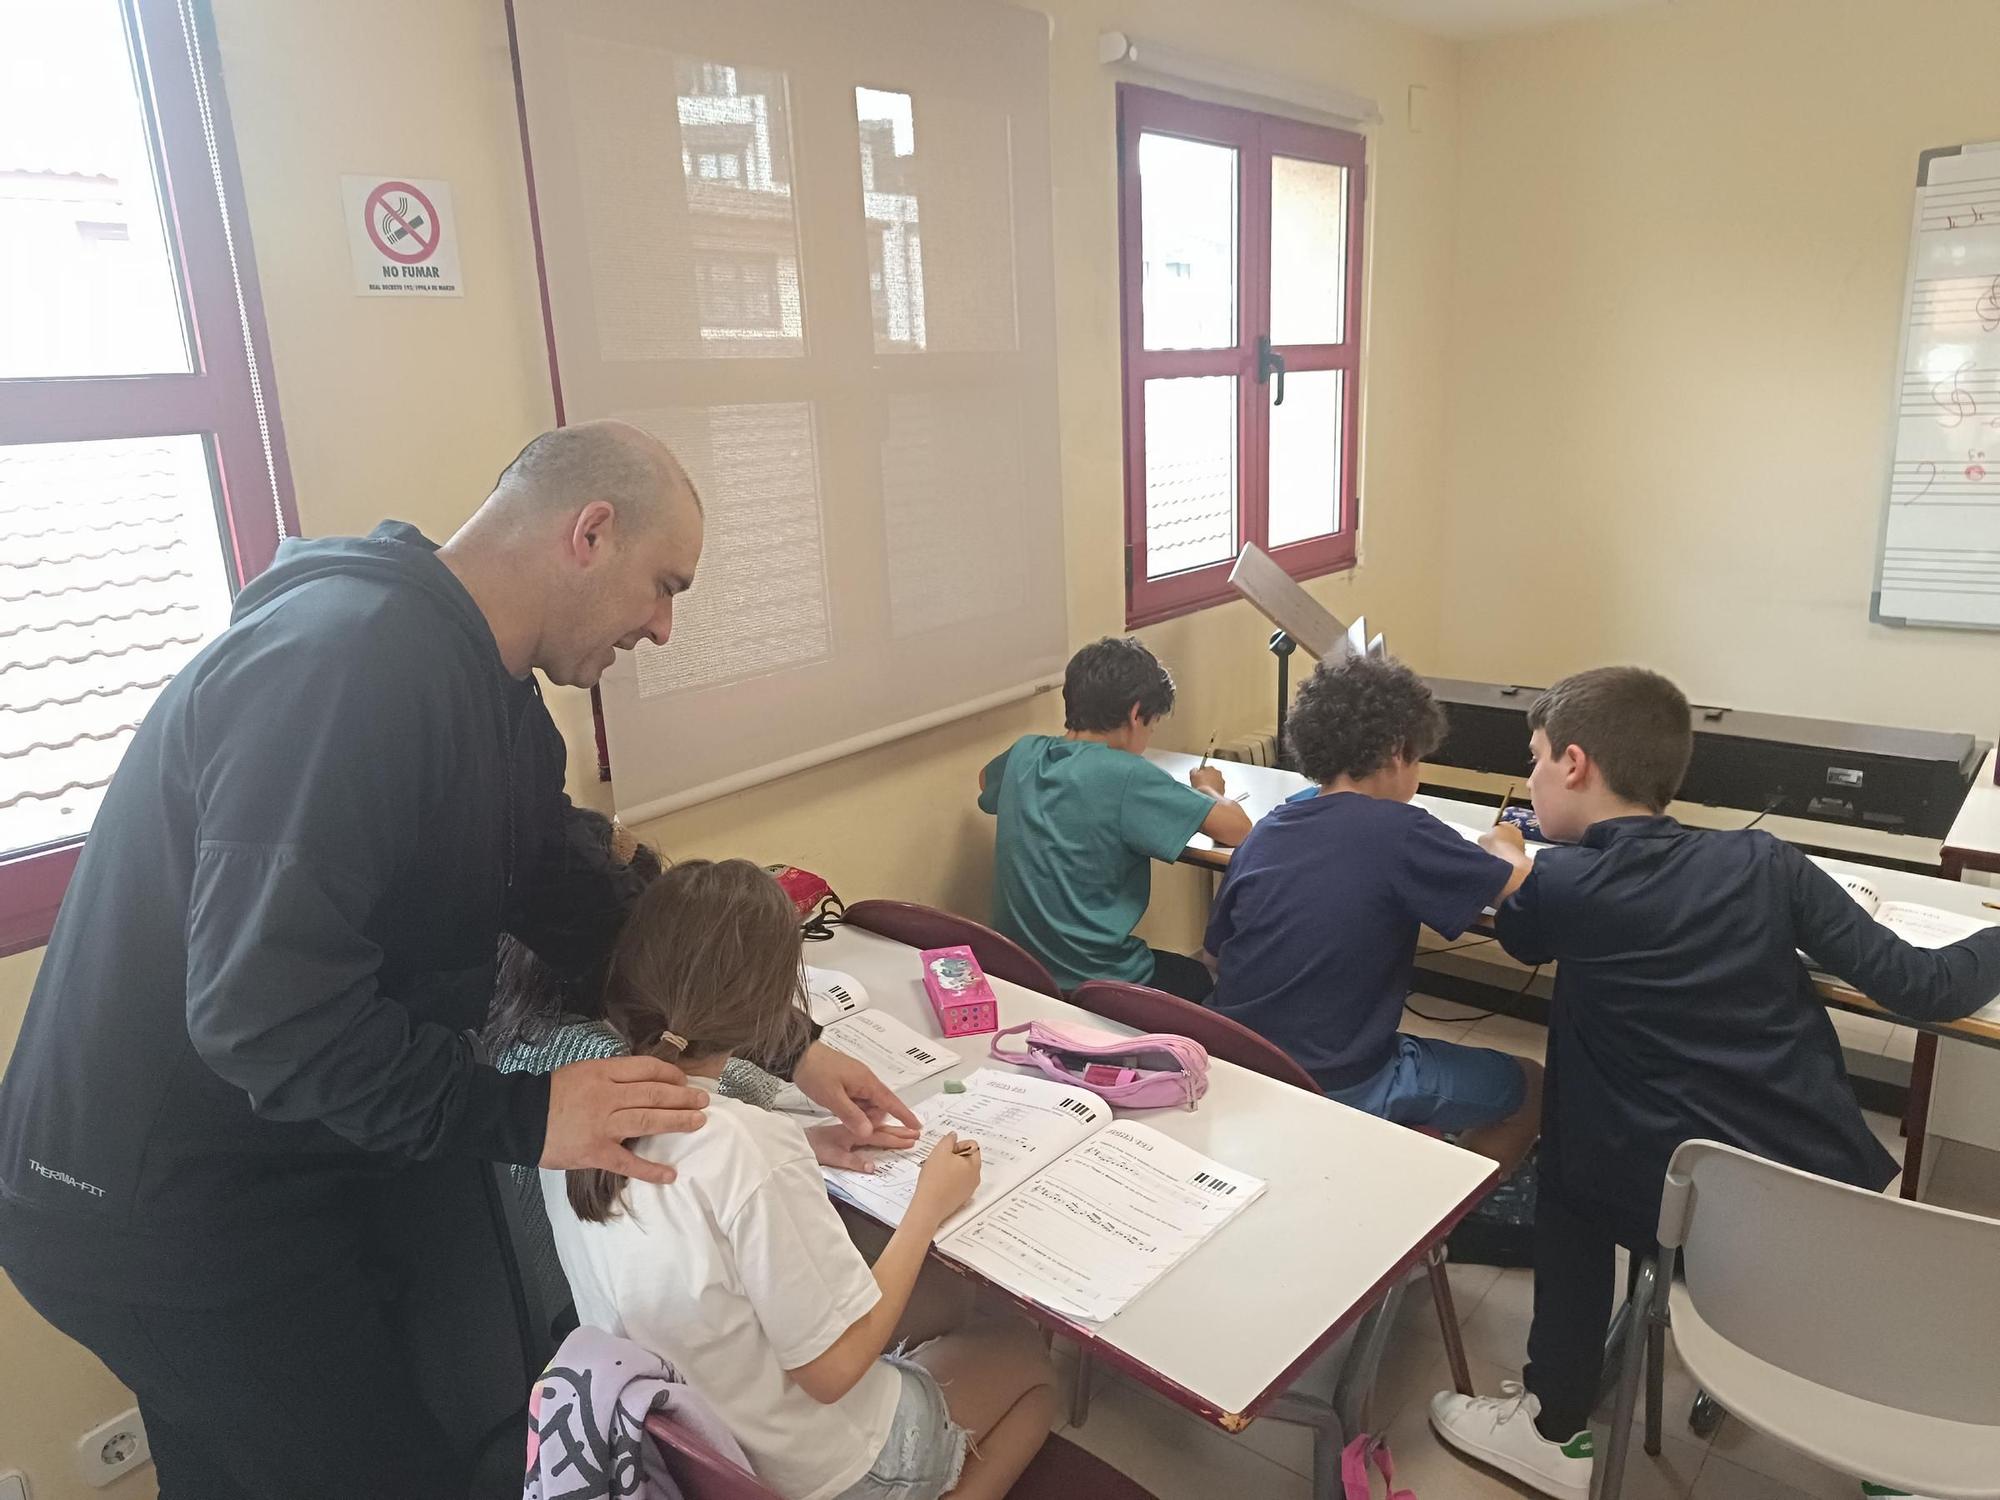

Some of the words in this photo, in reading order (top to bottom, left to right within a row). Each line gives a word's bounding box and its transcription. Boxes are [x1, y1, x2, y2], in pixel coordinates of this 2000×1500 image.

[382, 266, 399, 278] NO
[401, 266, 440, 278] FUMAR
[29, 1158, 106, 1197] THERMA-FIT
